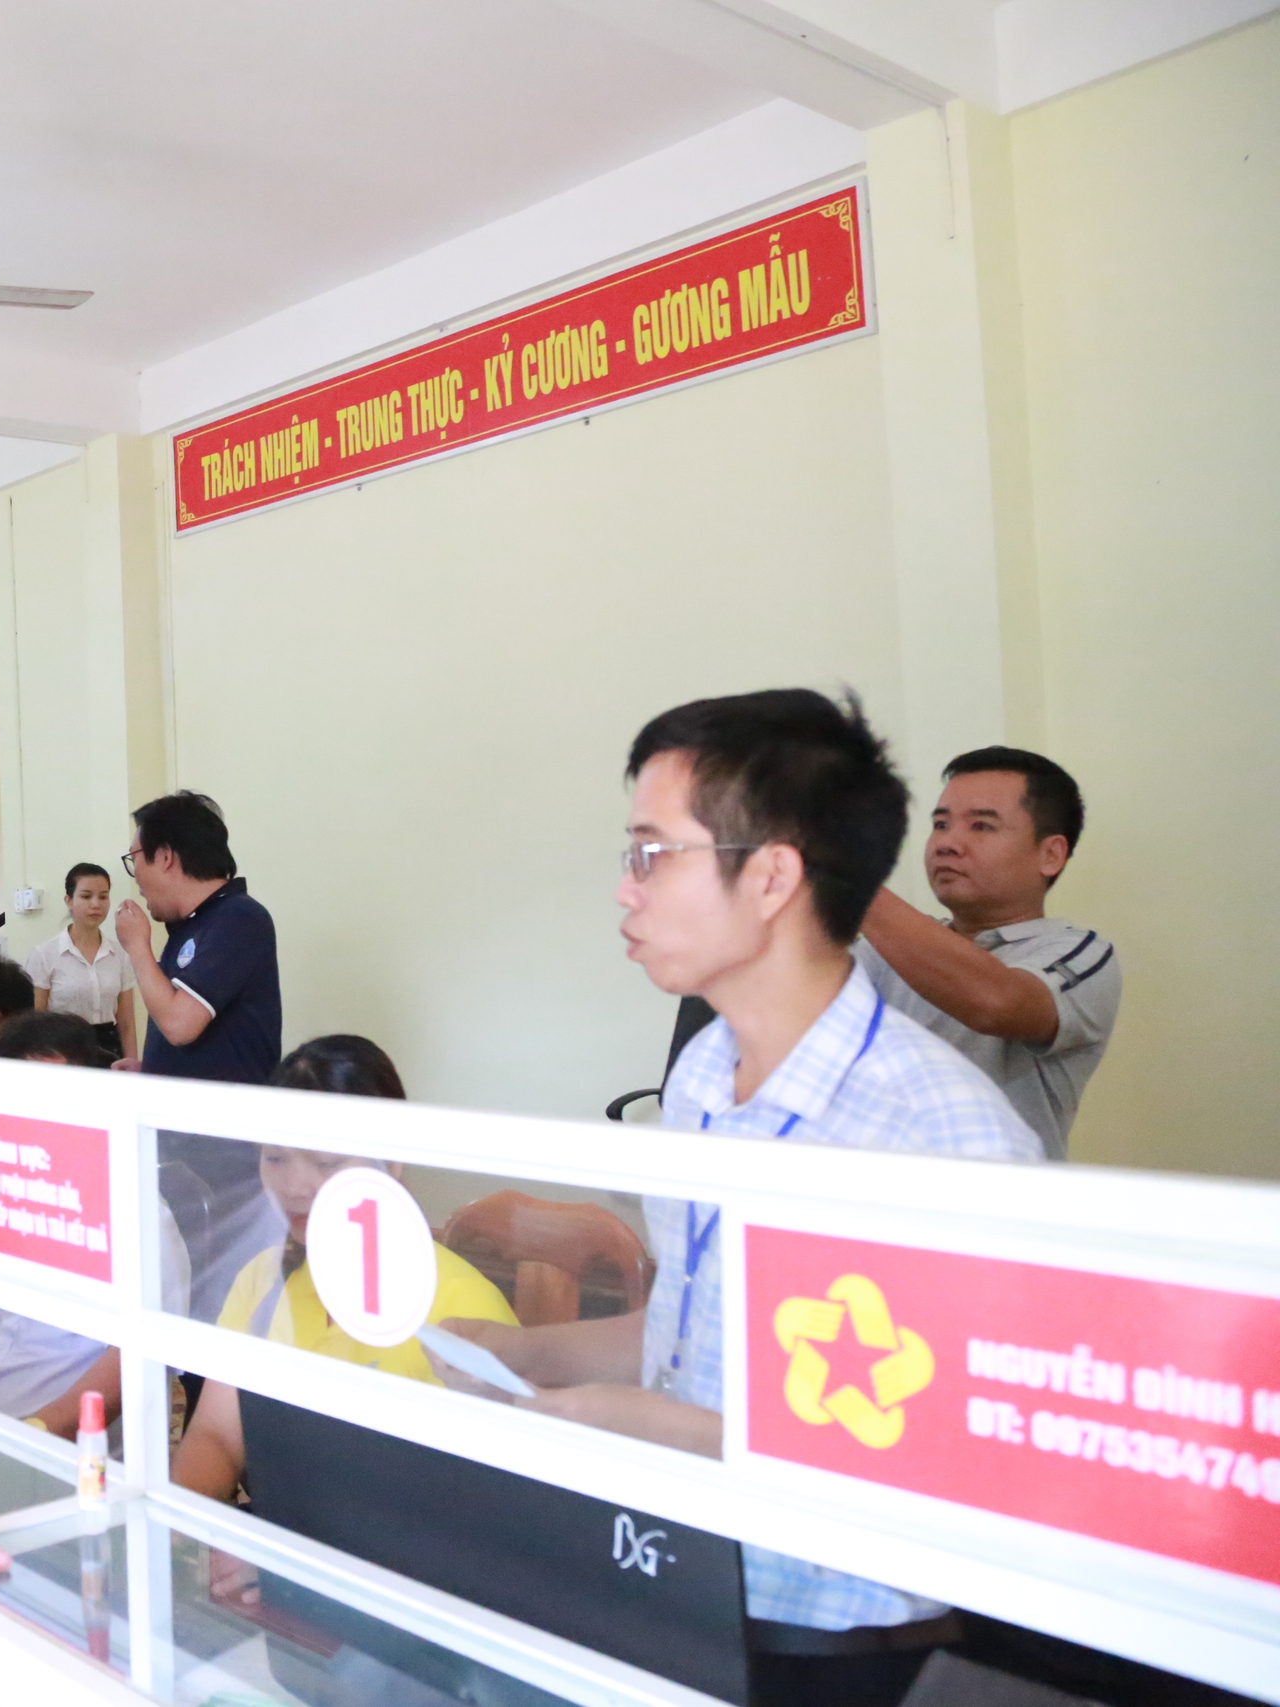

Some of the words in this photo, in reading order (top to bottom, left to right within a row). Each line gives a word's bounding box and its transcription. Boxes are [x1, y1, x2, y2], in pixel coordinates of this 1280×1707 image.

[201, 439, 256, 501] TRÁCH
[260, 415, 319, 484] NHIỆM
[336, 390, 404, 459] TRUNG
[407, 366, 465, 440] THỰC
[483, 332, 514, 412] KỶ
[521, 319, 609, 400] CƯƠNG
[632, 277, 732, 366] GƯƠNG
[737, 231, 811, 333] MẪU
[348, 1198, 379, 1316] 1
